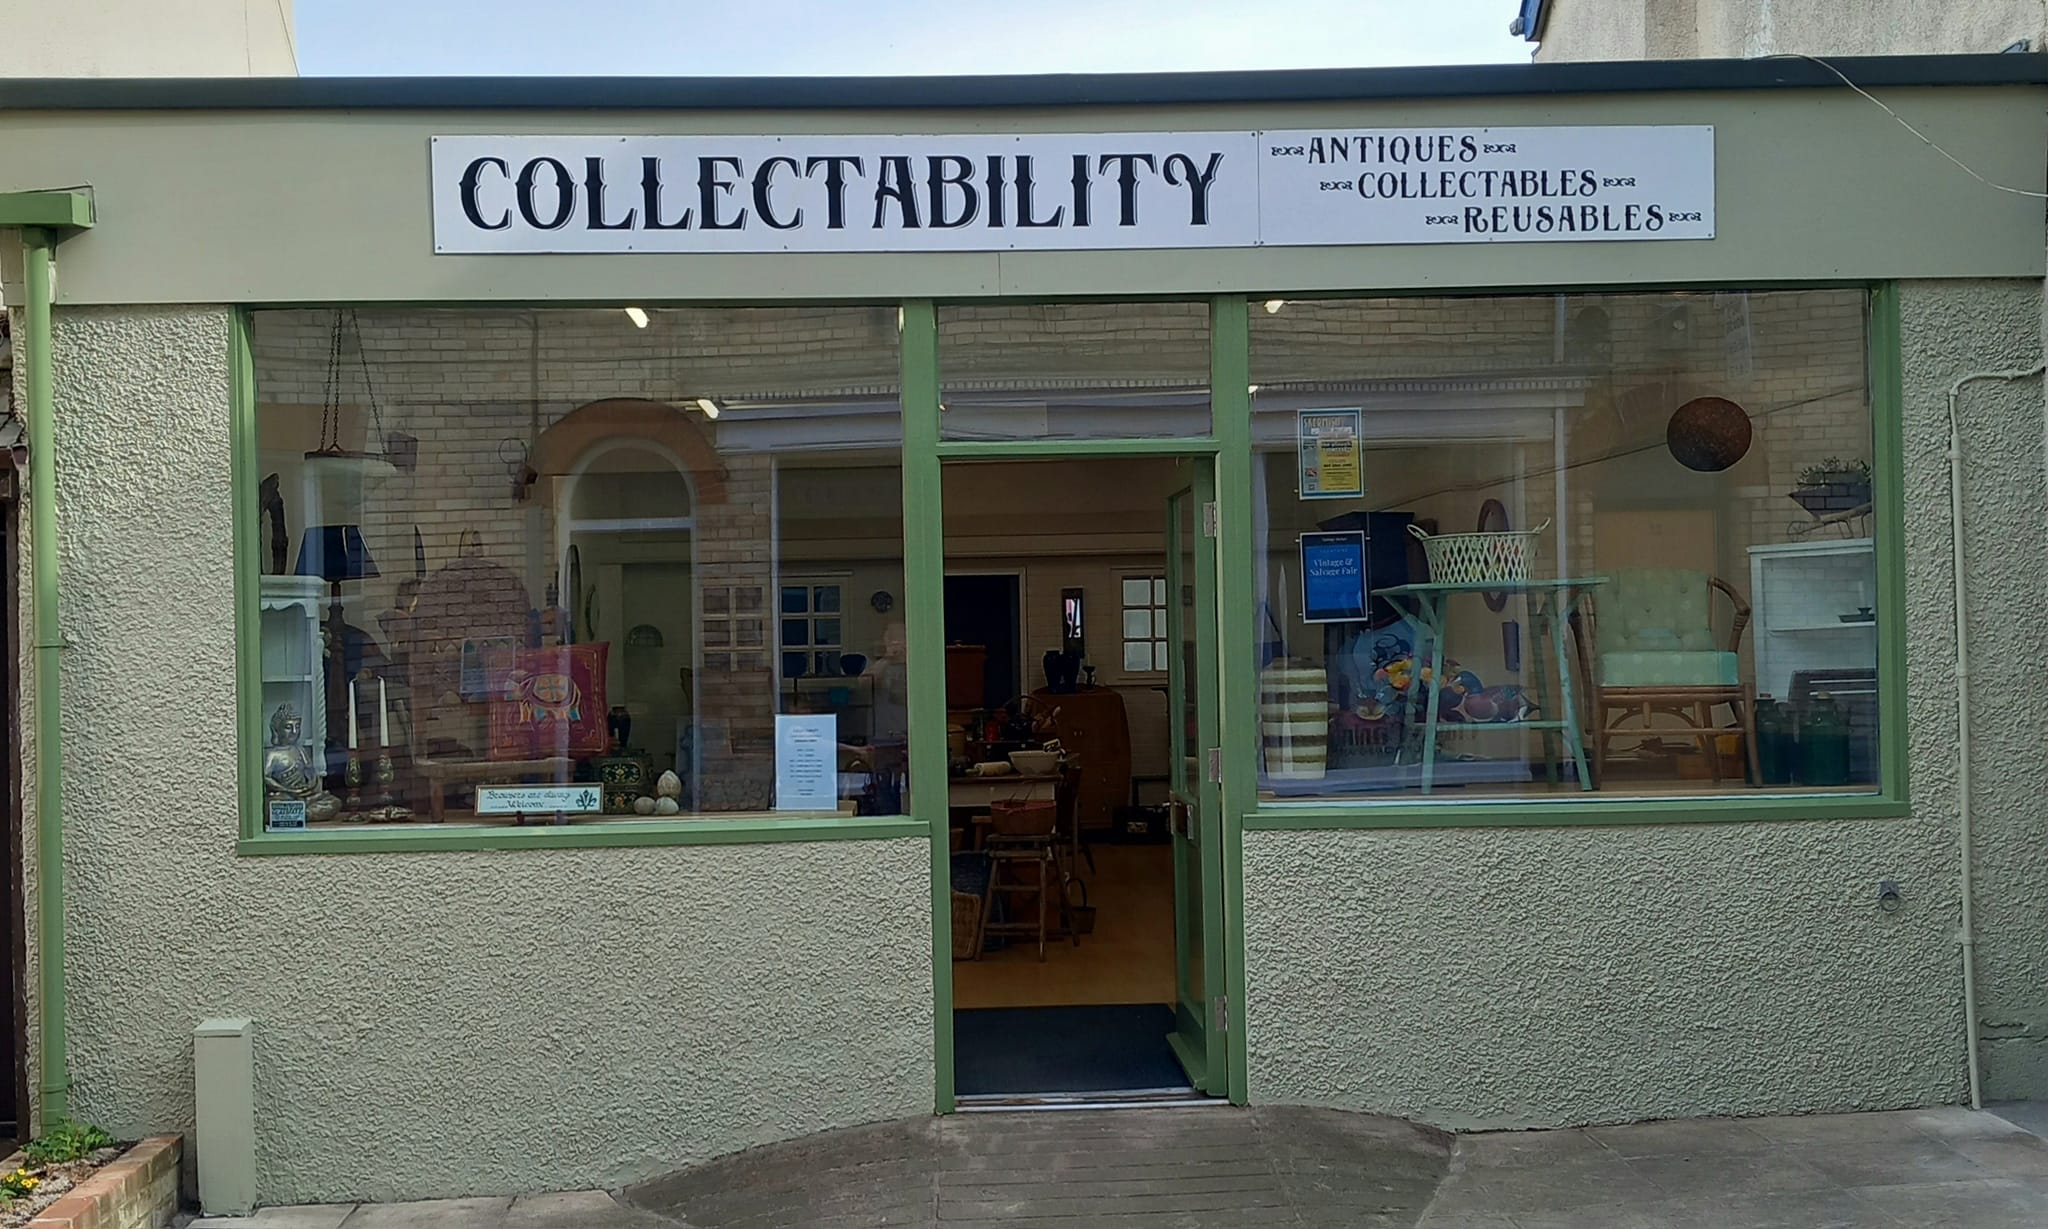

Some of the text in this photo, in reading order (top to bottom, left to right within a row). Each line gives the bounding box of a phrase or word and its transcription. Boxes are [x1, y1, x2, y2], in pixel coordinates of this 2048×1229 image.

[1308, 135, 1478, 165] ANTIQUES
[459, 152, 1225, 231] COLLECTABILITY
[1358, 169, 1598, 199] COLLECTABLES
[1464, 204, 1664, 233] REUSABLES
[1309, 567, 1358, 577] Salvage Fair
[1314, 558, 1353, 568] Vintage &
